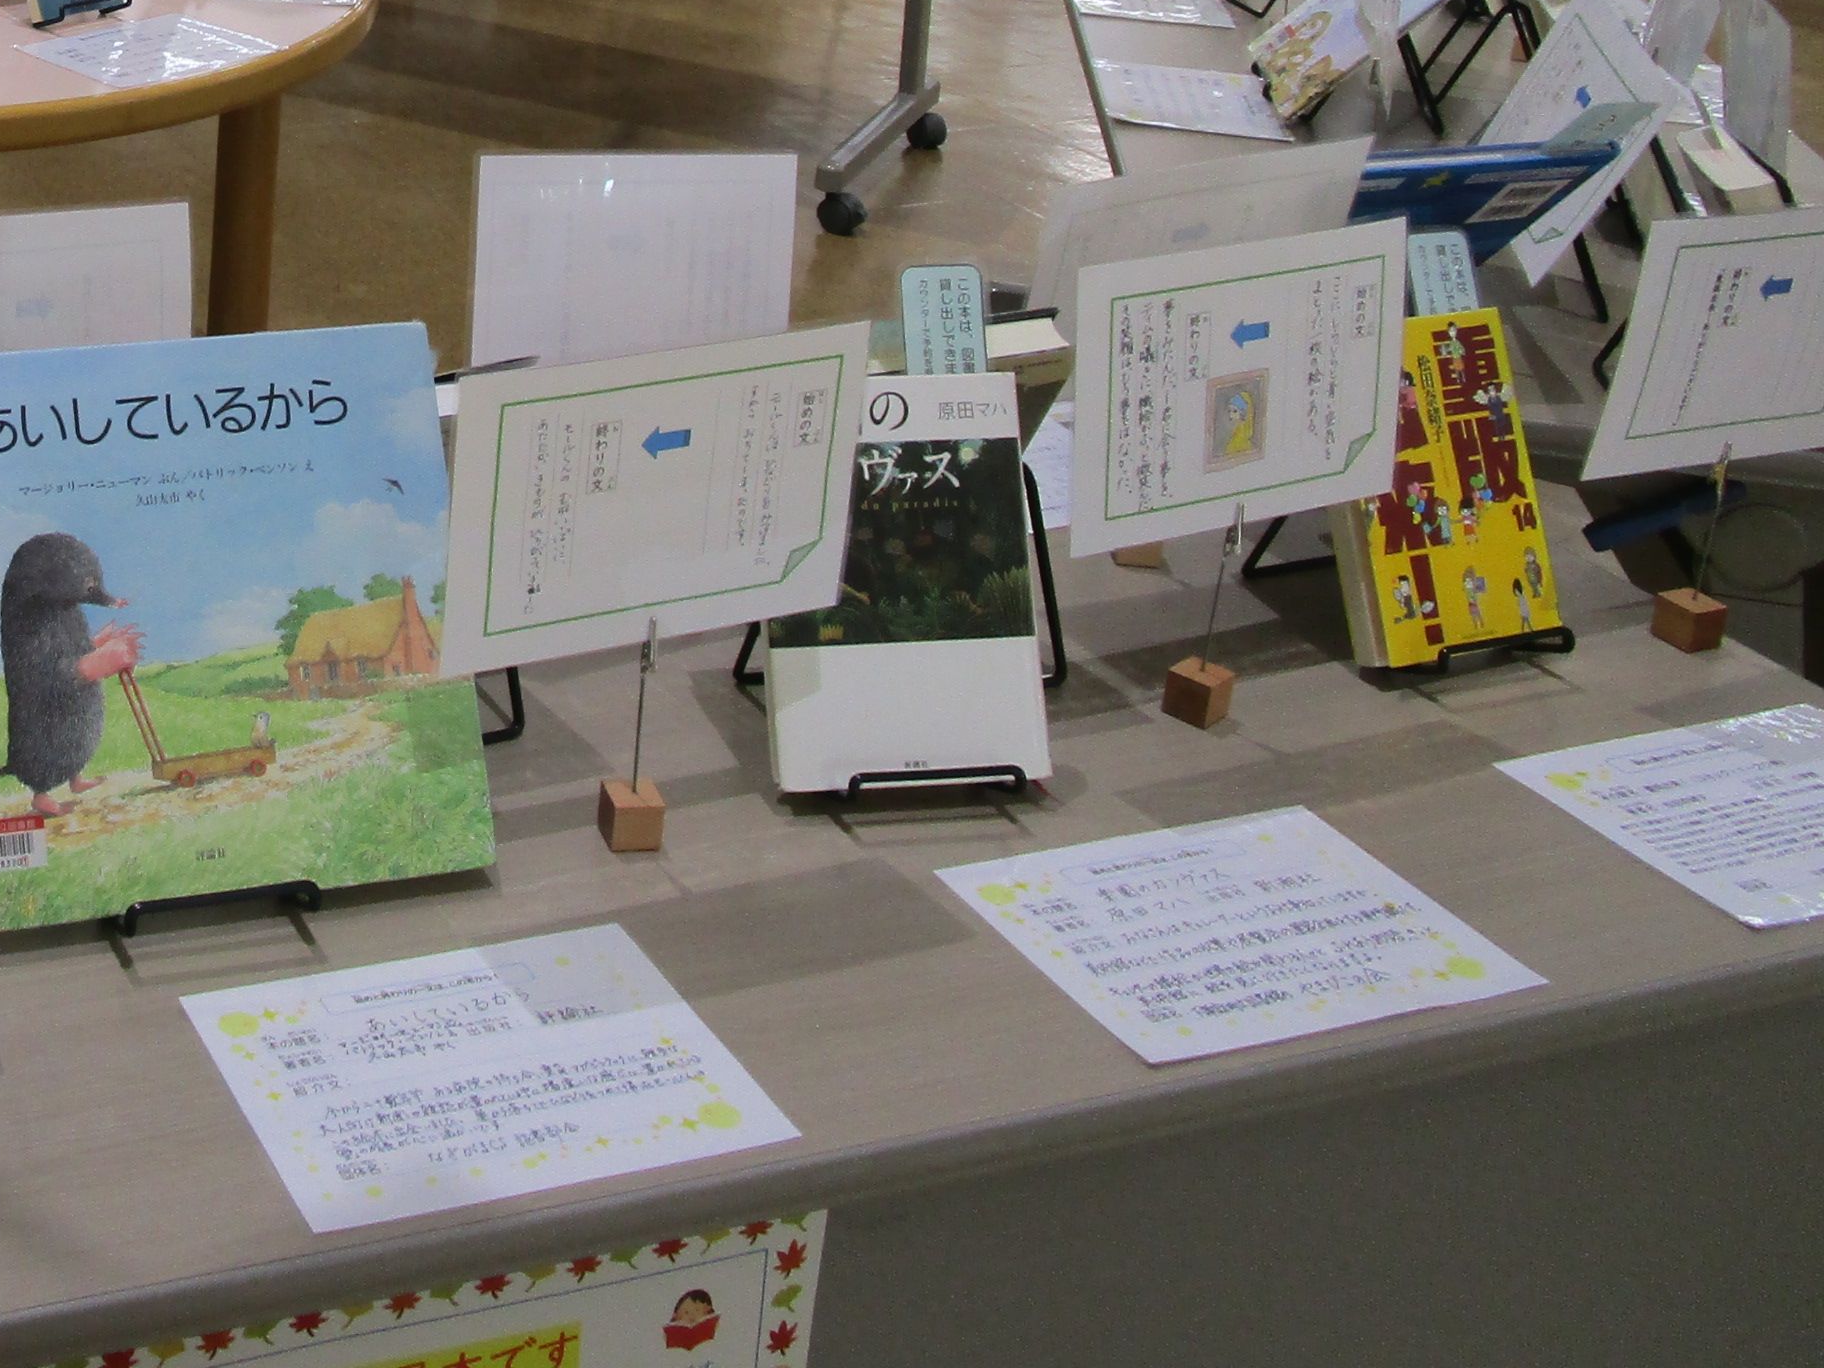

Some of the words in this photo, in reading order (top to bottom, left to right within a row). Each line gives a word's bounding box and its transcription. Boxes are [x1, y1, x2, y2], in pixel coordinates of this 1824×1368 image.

[869, 390, 909, 431] の
[938, 400, 1007, 420] 原田マハ
[1511, 502, 1537, 532] 14
[367, 987, 532, 1032] あいしているから
